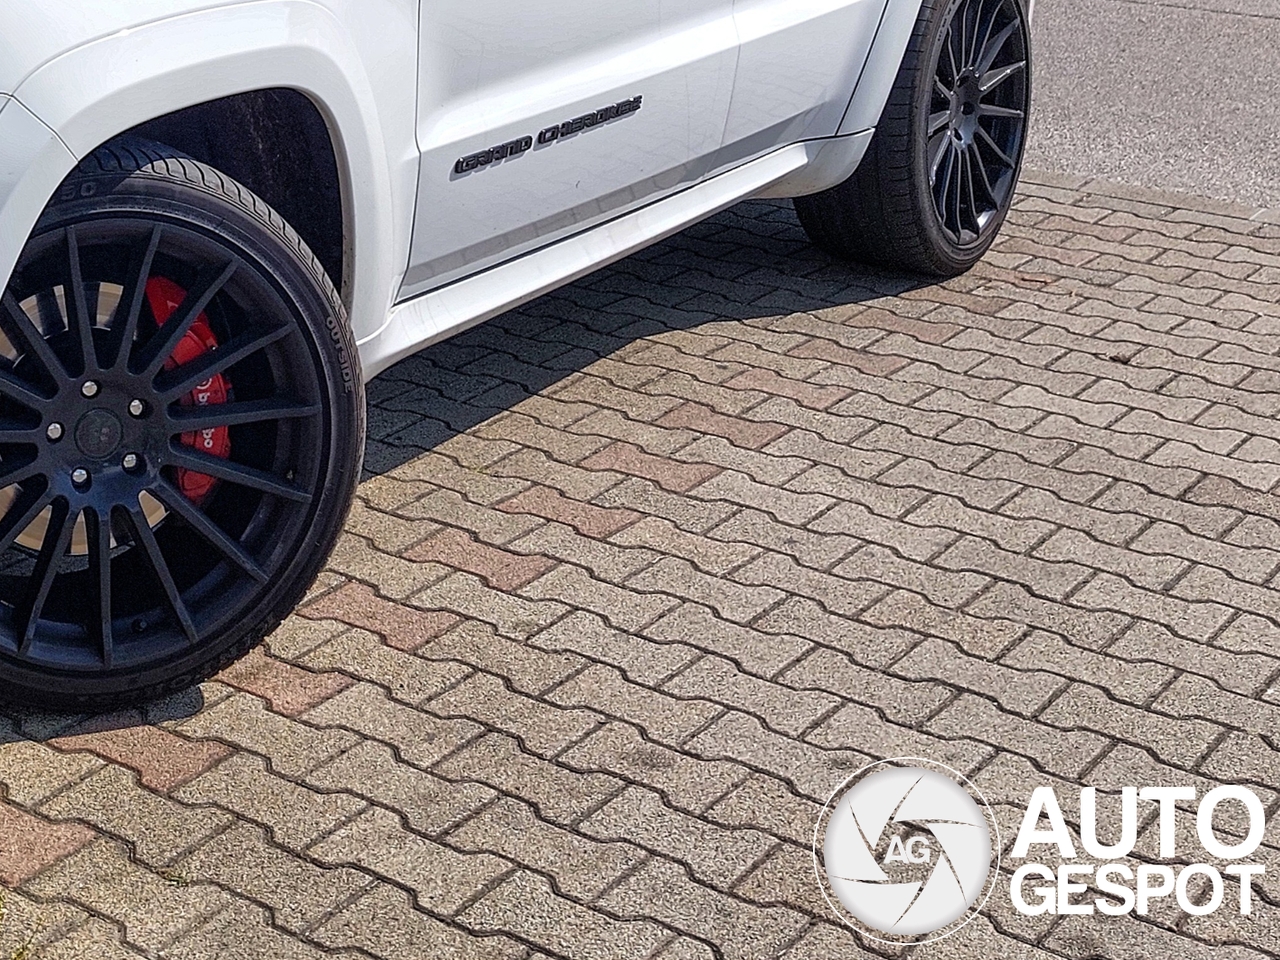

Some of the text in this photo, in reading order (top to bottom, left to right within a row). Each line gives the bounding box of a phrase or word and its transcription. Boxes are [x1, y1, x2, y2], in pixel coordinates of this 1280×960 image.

[454, 95, 643, 174] GRAND CHEROKEE
[326, 316, 354, 394] OUTSIDE
